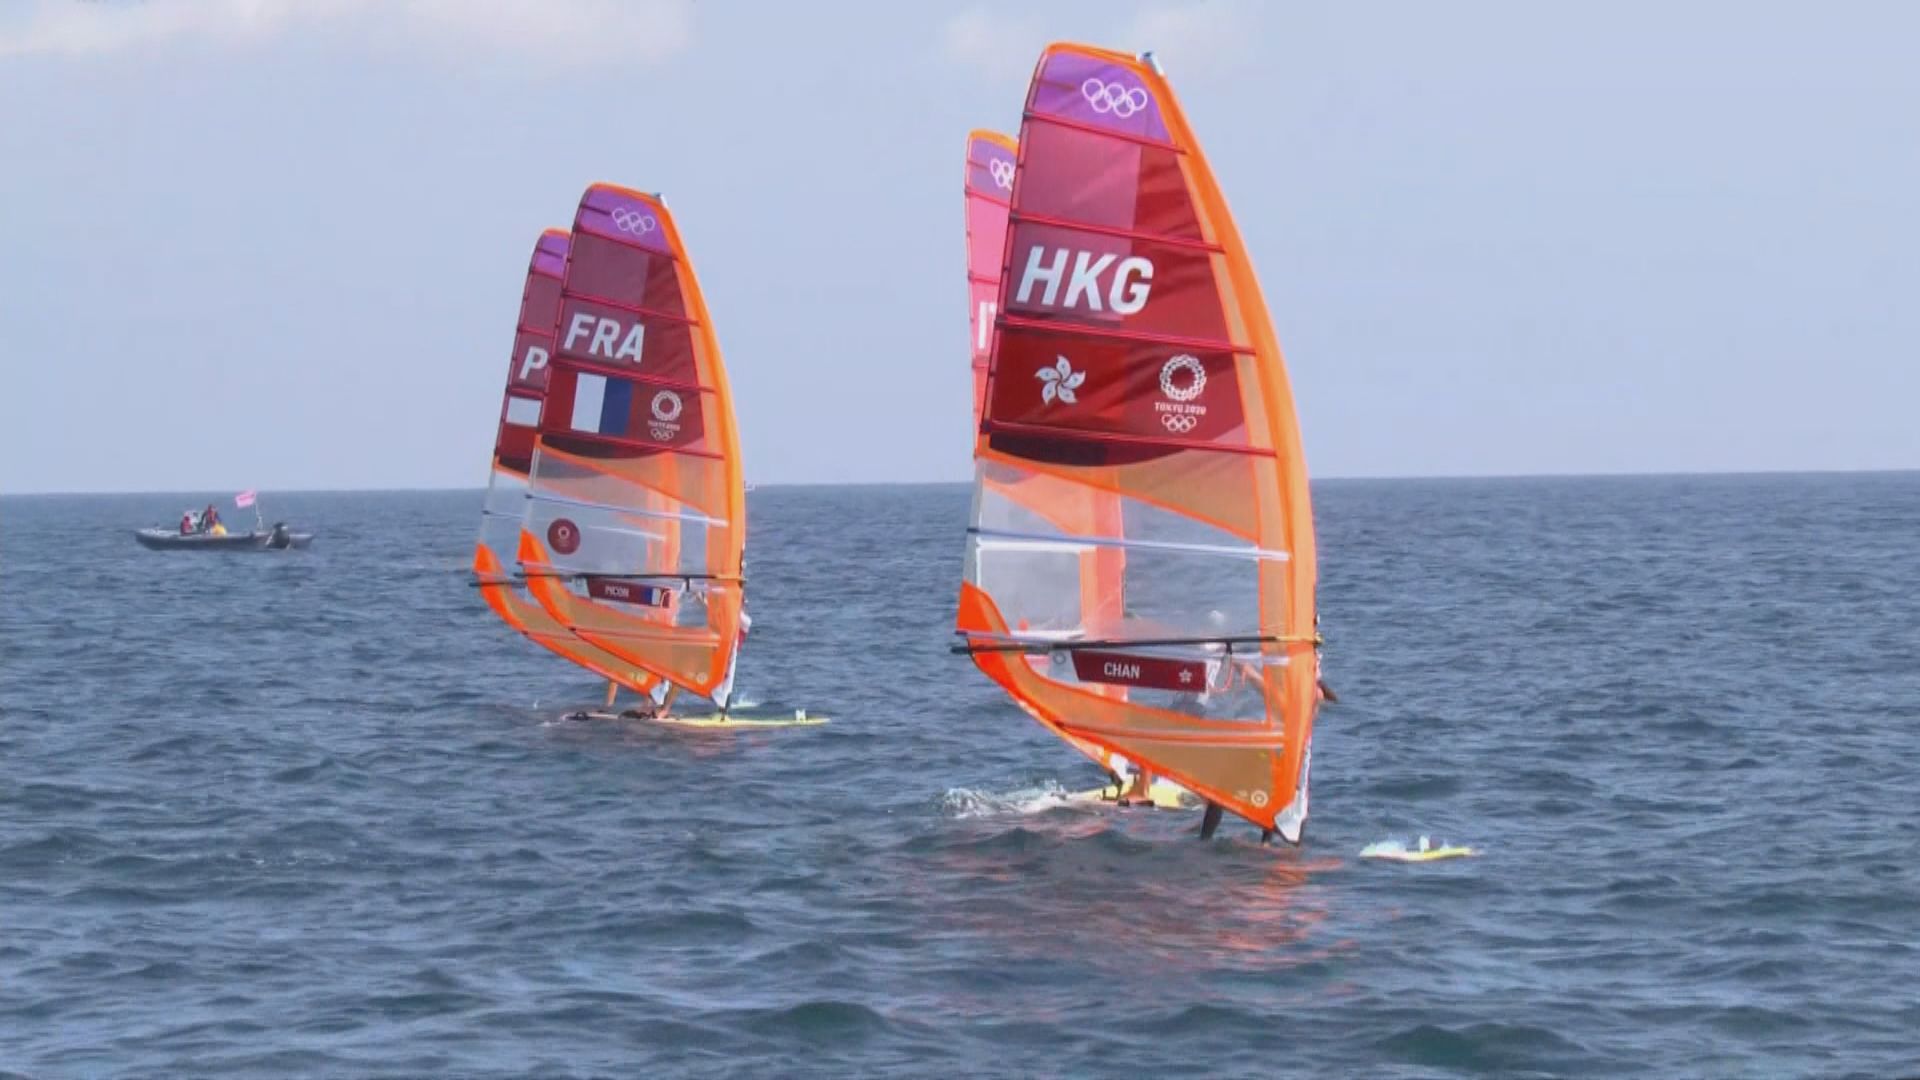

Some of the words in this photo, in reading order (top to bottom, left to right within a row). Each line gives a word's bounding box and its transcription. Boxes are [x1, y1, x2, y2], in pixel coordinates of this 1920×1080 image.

[1015, 246, 1154, 315] HKG
[563, 312, 645, 363] FRA
[519, 346, 548, 380] P
[1104, 662, 1141, 678] CHAN
